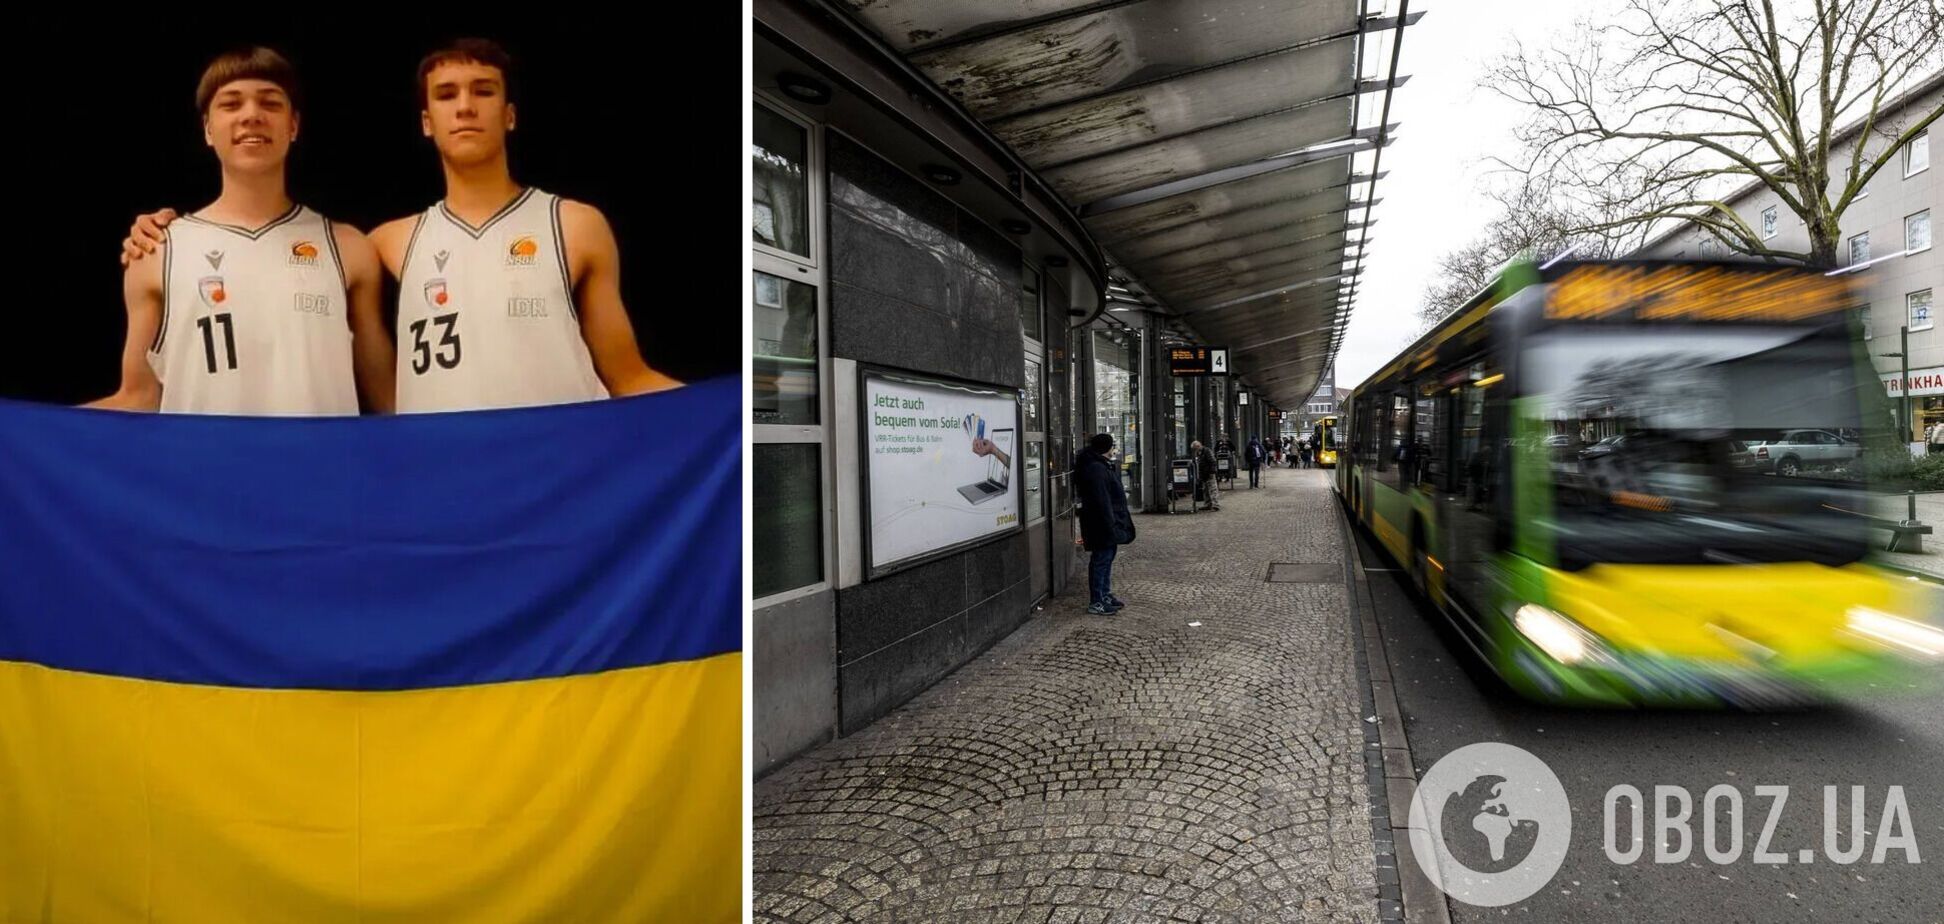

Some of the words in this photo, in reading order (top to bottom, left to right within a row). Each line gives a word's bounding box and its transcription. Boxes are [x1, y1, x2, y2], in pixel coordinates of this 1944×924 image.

[197, 313, 237, 373] 11
[409, 312, 461, 375] 33
[1215, 355, 1223, 367] 4
[874, 393, 900, 409] Jetzt
[902, 397, 925, 410] auch
[874, 411, 917, 430] bequem
[919, 418, 938, 428] vom
[940, 416, 961, 429] Sofa!
[996, 512, 1017, 526] STOAG
